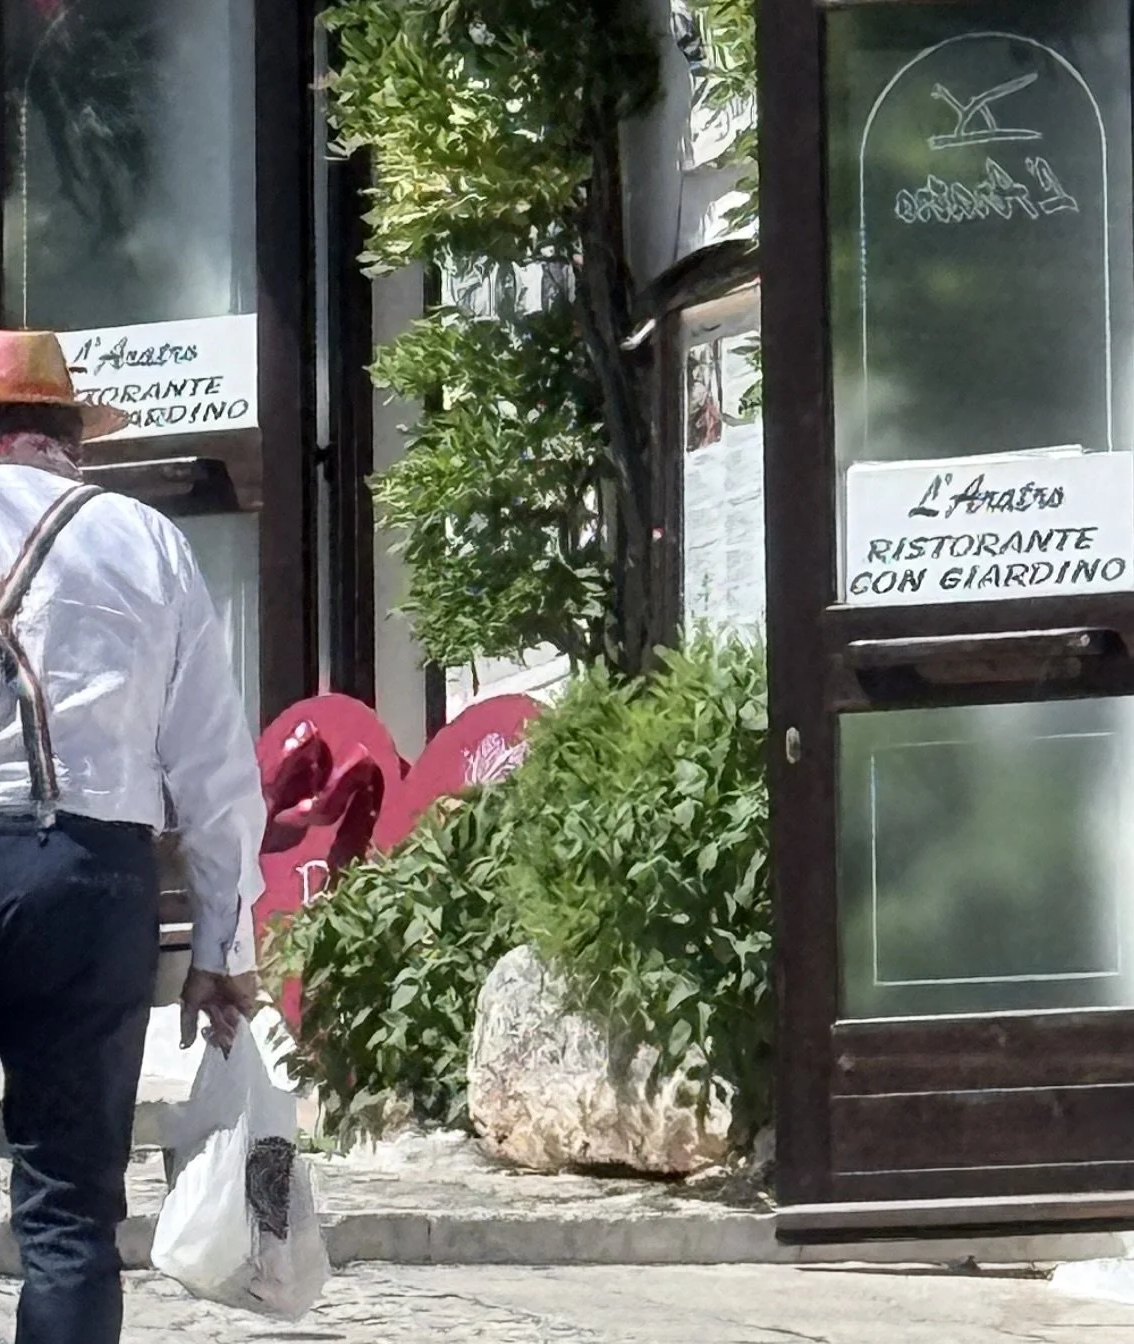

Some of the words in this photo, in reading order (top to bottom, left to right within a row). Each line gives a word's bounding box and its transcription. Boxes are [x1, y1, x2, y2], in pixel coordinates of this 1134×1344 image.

[76, 376, 224, 406] TORANTE
[126, 399, 249, 429] ARDINO
[867, 527, 1099, 564] RISTORANTE
[850, 568, 926, 596] CON
[940, 557, 1127, 590] GIARDINO
